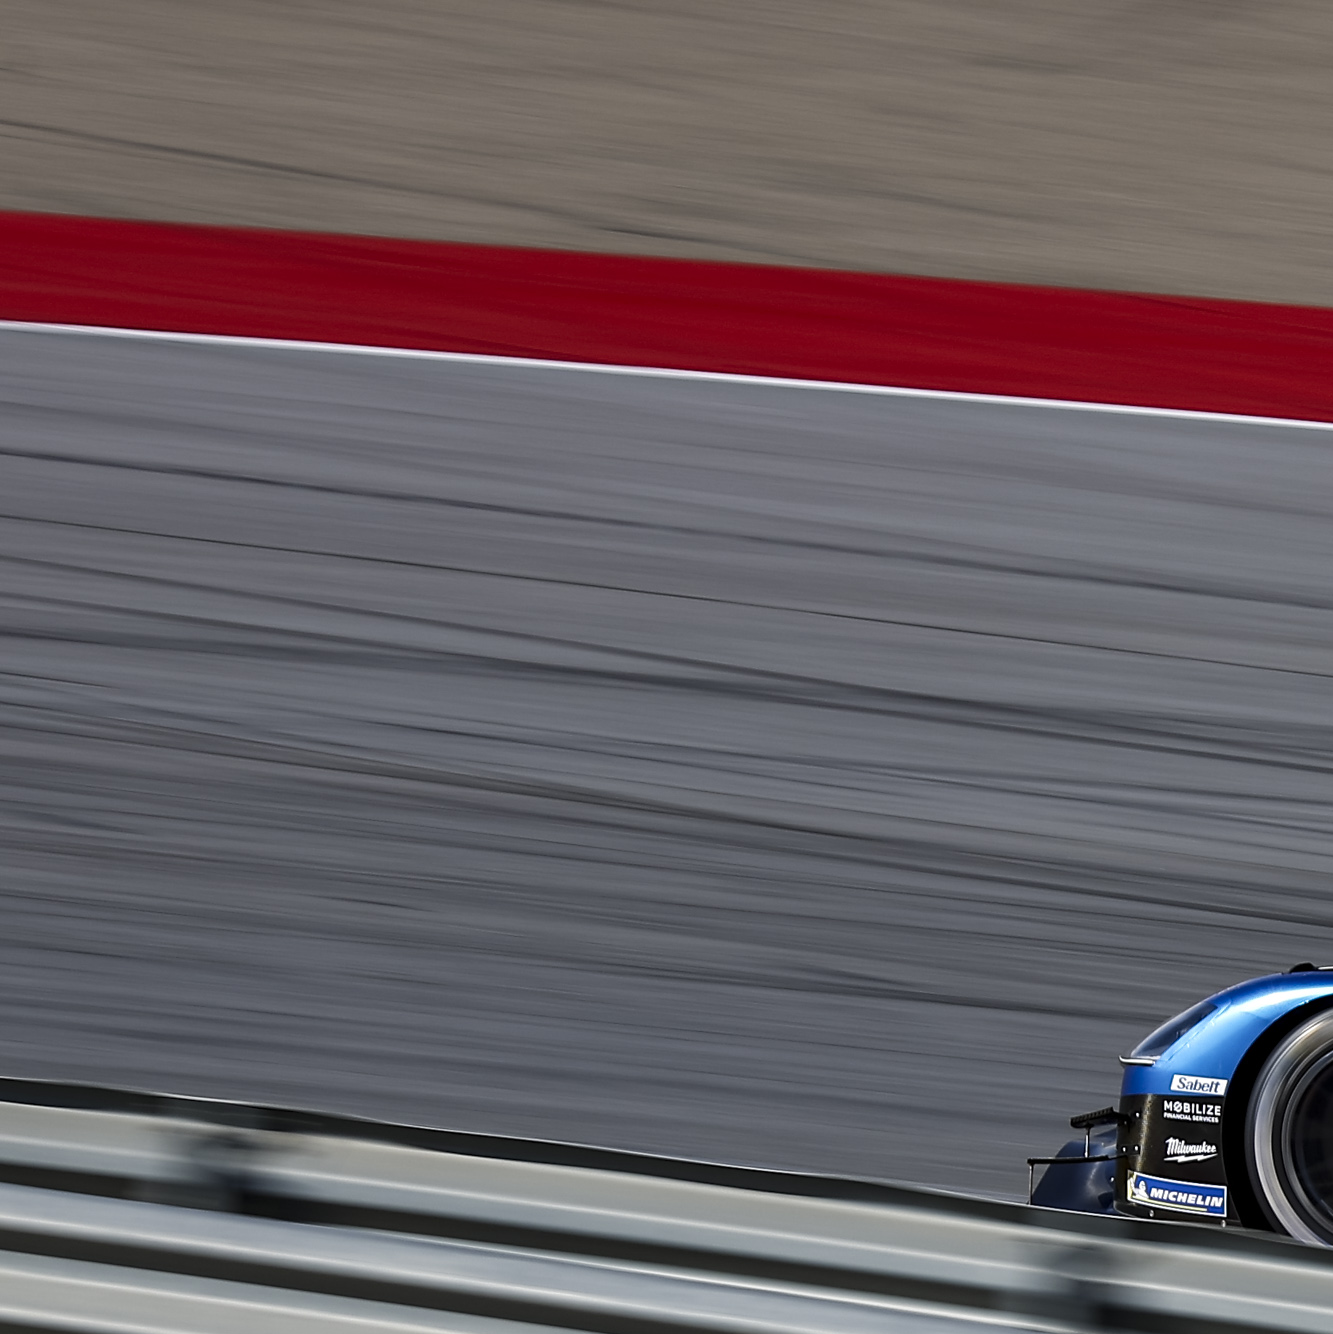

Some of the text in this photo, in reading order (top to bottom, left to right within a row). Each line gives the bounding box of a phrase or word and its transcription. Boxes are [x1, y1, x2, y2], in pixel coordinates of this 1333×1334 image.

[1177, 1077, 1220, 1093] Sabelt
[1163, 1112, 1219, 1123] FINANCIAL SERVICES
[1165, 1137, 1217, 1155] Milwaukee
[1150, 1187, 1223, 1207] MICHELIN
